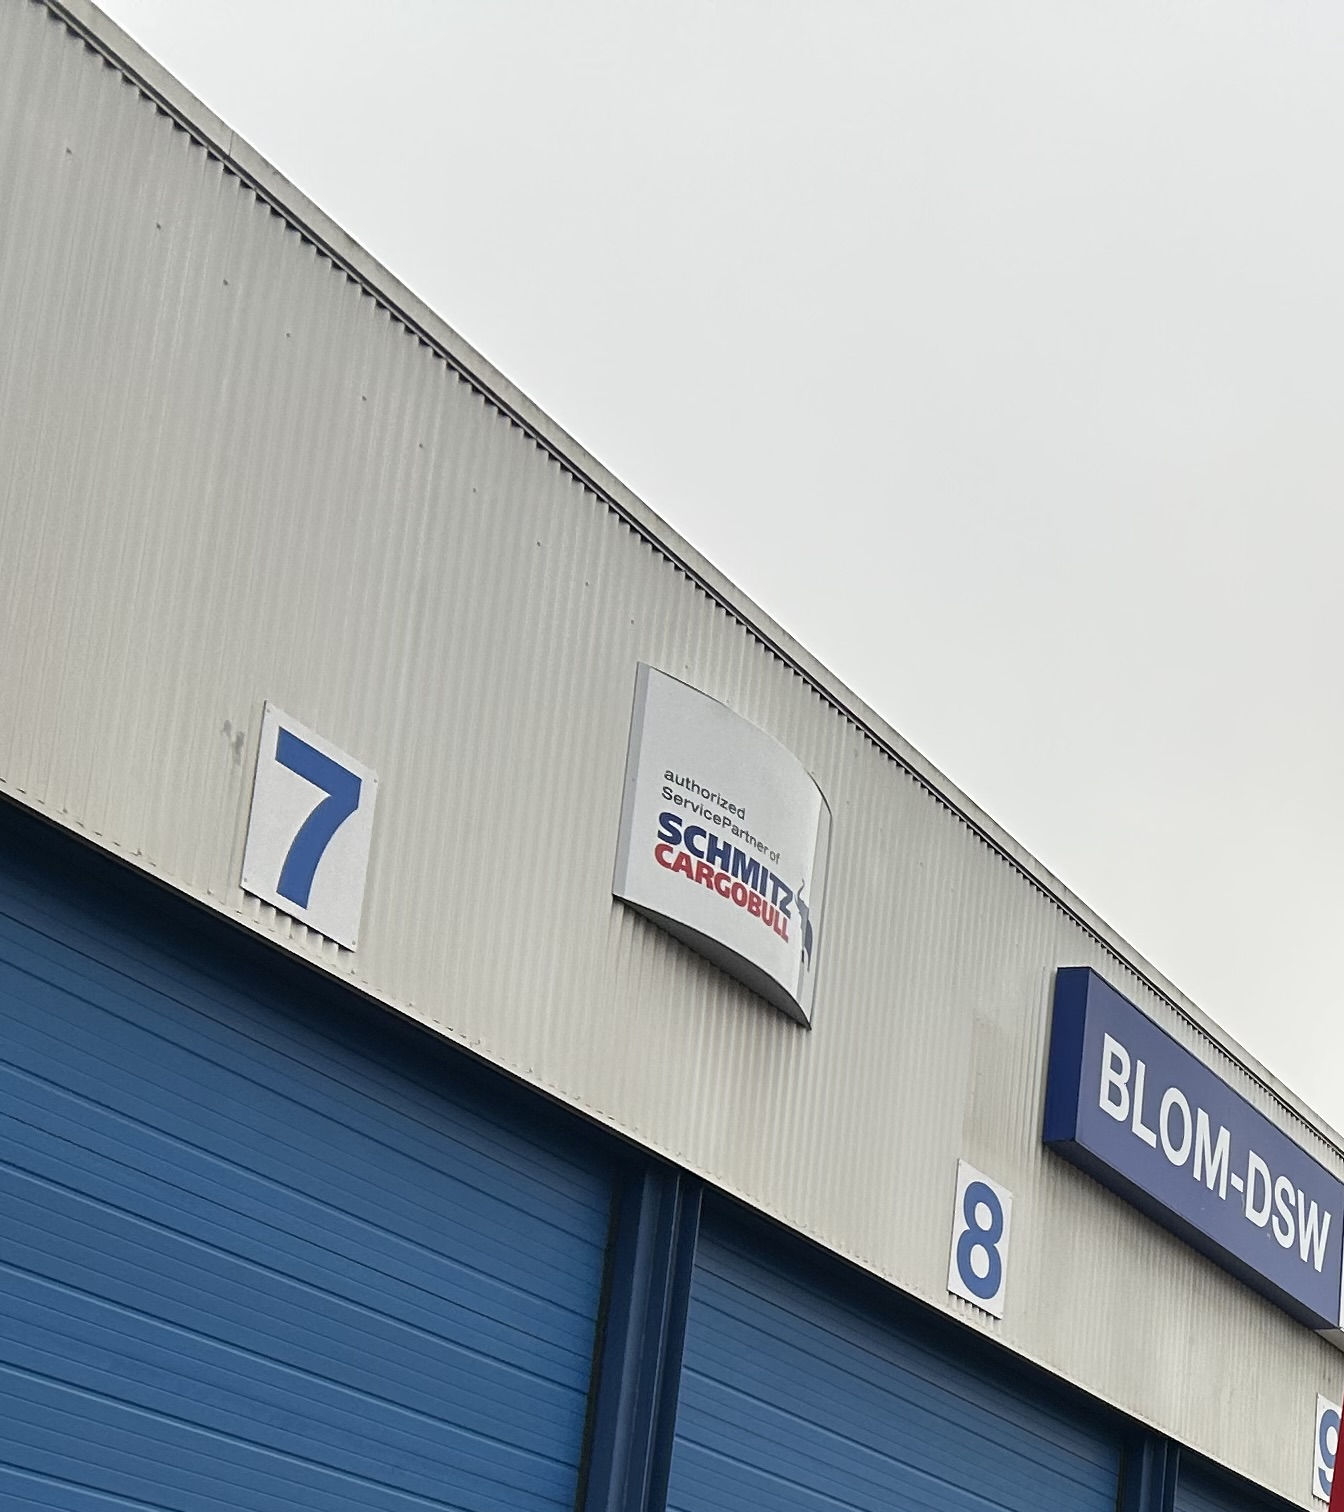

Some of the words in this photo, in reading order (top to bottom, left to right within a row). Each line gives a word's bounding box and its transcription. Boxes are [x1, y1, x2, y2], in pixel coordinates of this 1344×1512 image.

[275, 726, 361, 910] 7
[662, 786, 770, 857] ServicePartner
[769, 846, 781, 865] of
[664, 768, 746, 821] authorized
[654, 843, 790, 943] CARGOBULL
[656, 811, 793, 919] SCHMITZ
[1099, 1032, 1331, 1273] BLOM-DSW
[956, 1181, 1003, 1300] 8
